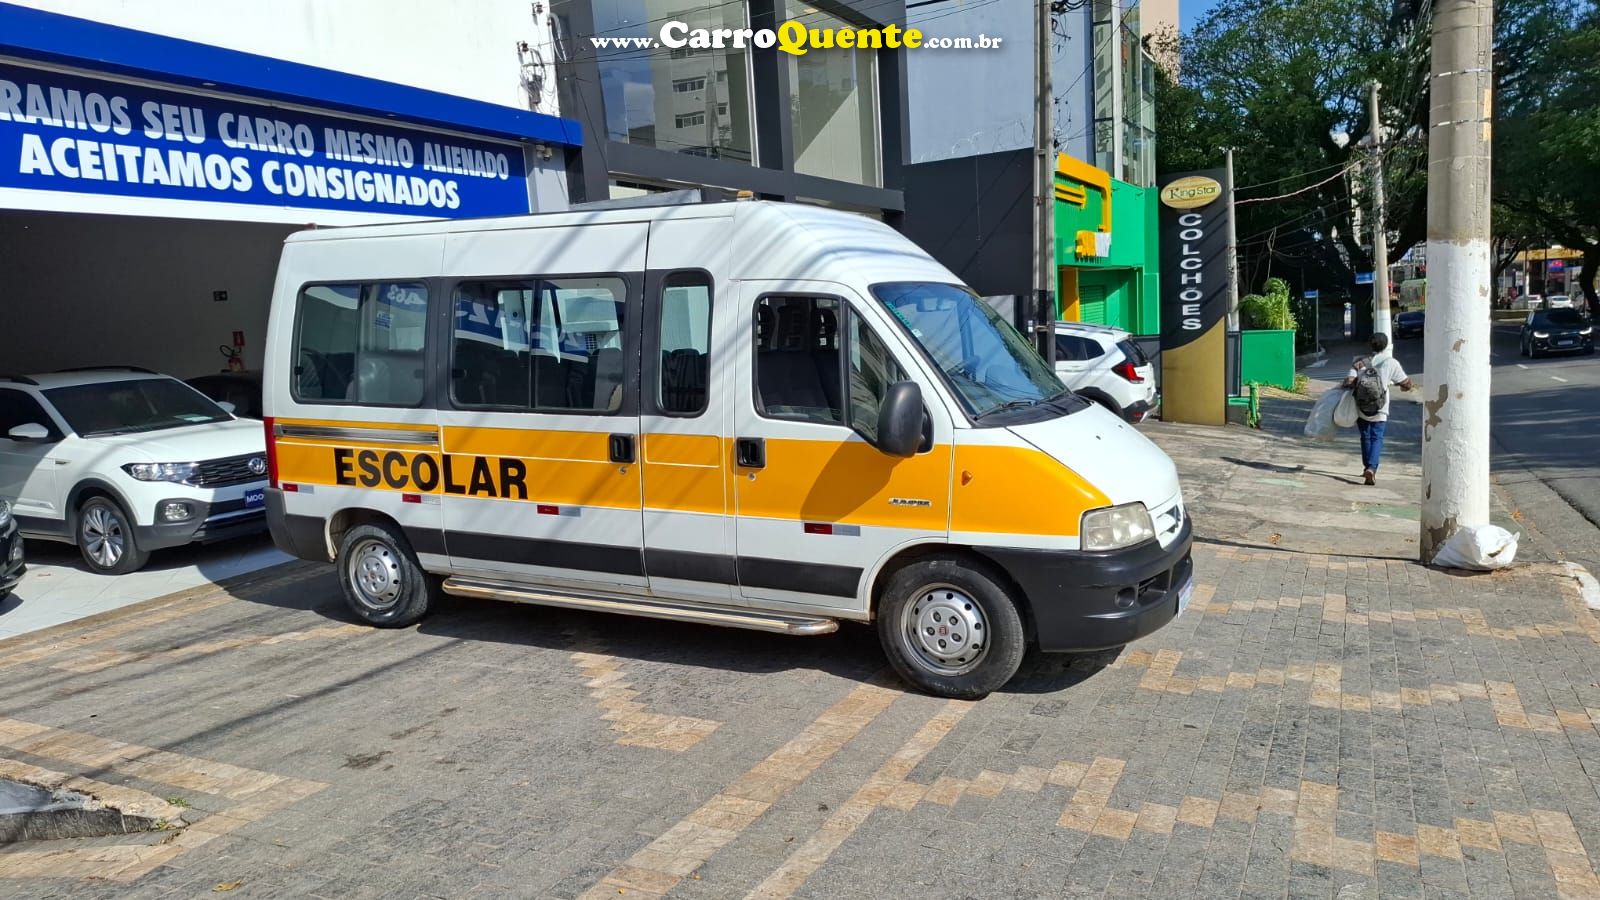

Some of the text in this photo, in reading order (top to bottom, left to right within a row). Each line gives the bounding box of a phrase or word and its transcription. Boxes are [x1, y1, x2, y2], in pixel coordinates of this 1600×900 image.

[19, 133, 461, 210] ACEITAMOS CONSIGNADOS
[141, 101, 206, 144] SEU
[217, 112, 314, 158] CARRO
[324, 127, 415, 169] MESMO
[423, 142, 510, 181] ALIENADO
[334, 448, 528, 500] ESCOLAR
